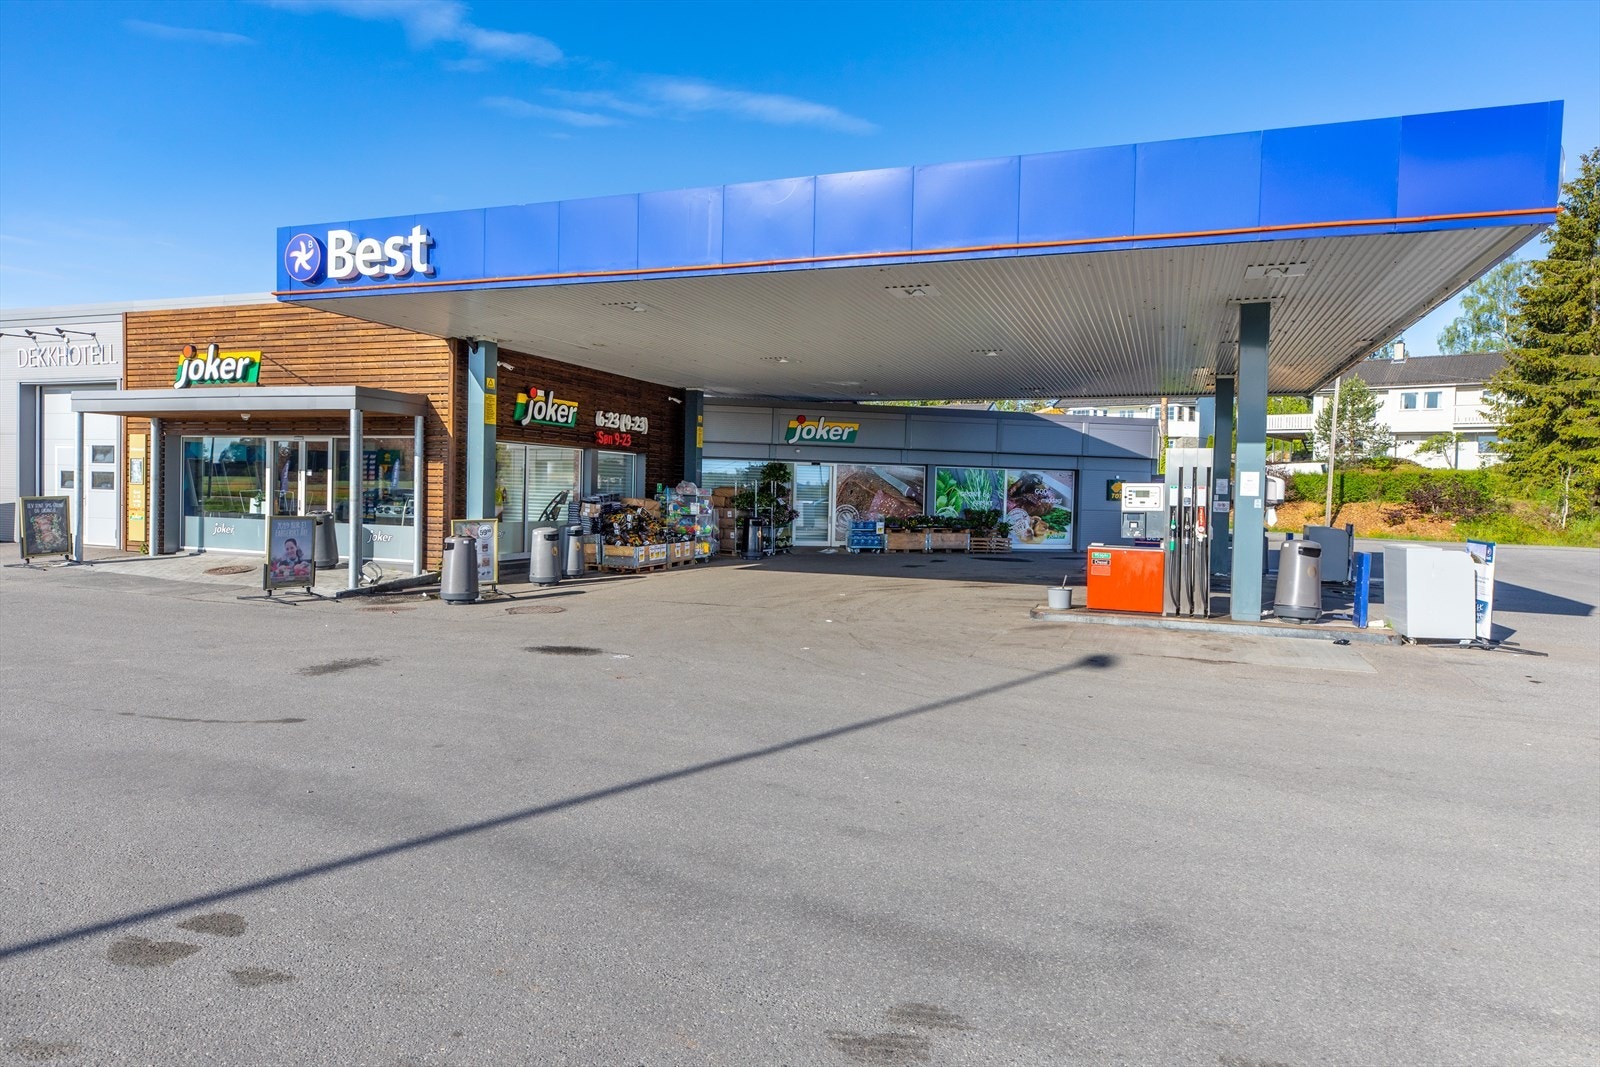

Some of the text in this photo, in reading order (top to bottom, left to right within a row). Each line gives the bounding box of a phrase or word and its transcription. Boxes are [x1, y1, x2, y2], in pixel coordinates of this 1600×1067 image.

[328, 225, 430, 279] Best
[17, 344, 118, 368] DEKKHOTELL
[174, 343, 252, 389] joker
[520, 387, 579, 427] joker
[614, 433, 632, 446] 9-23
[788, 414, 854, 444] joker
[212, 522, 235, 536] joker
[366, 529, 393, 544] joker
